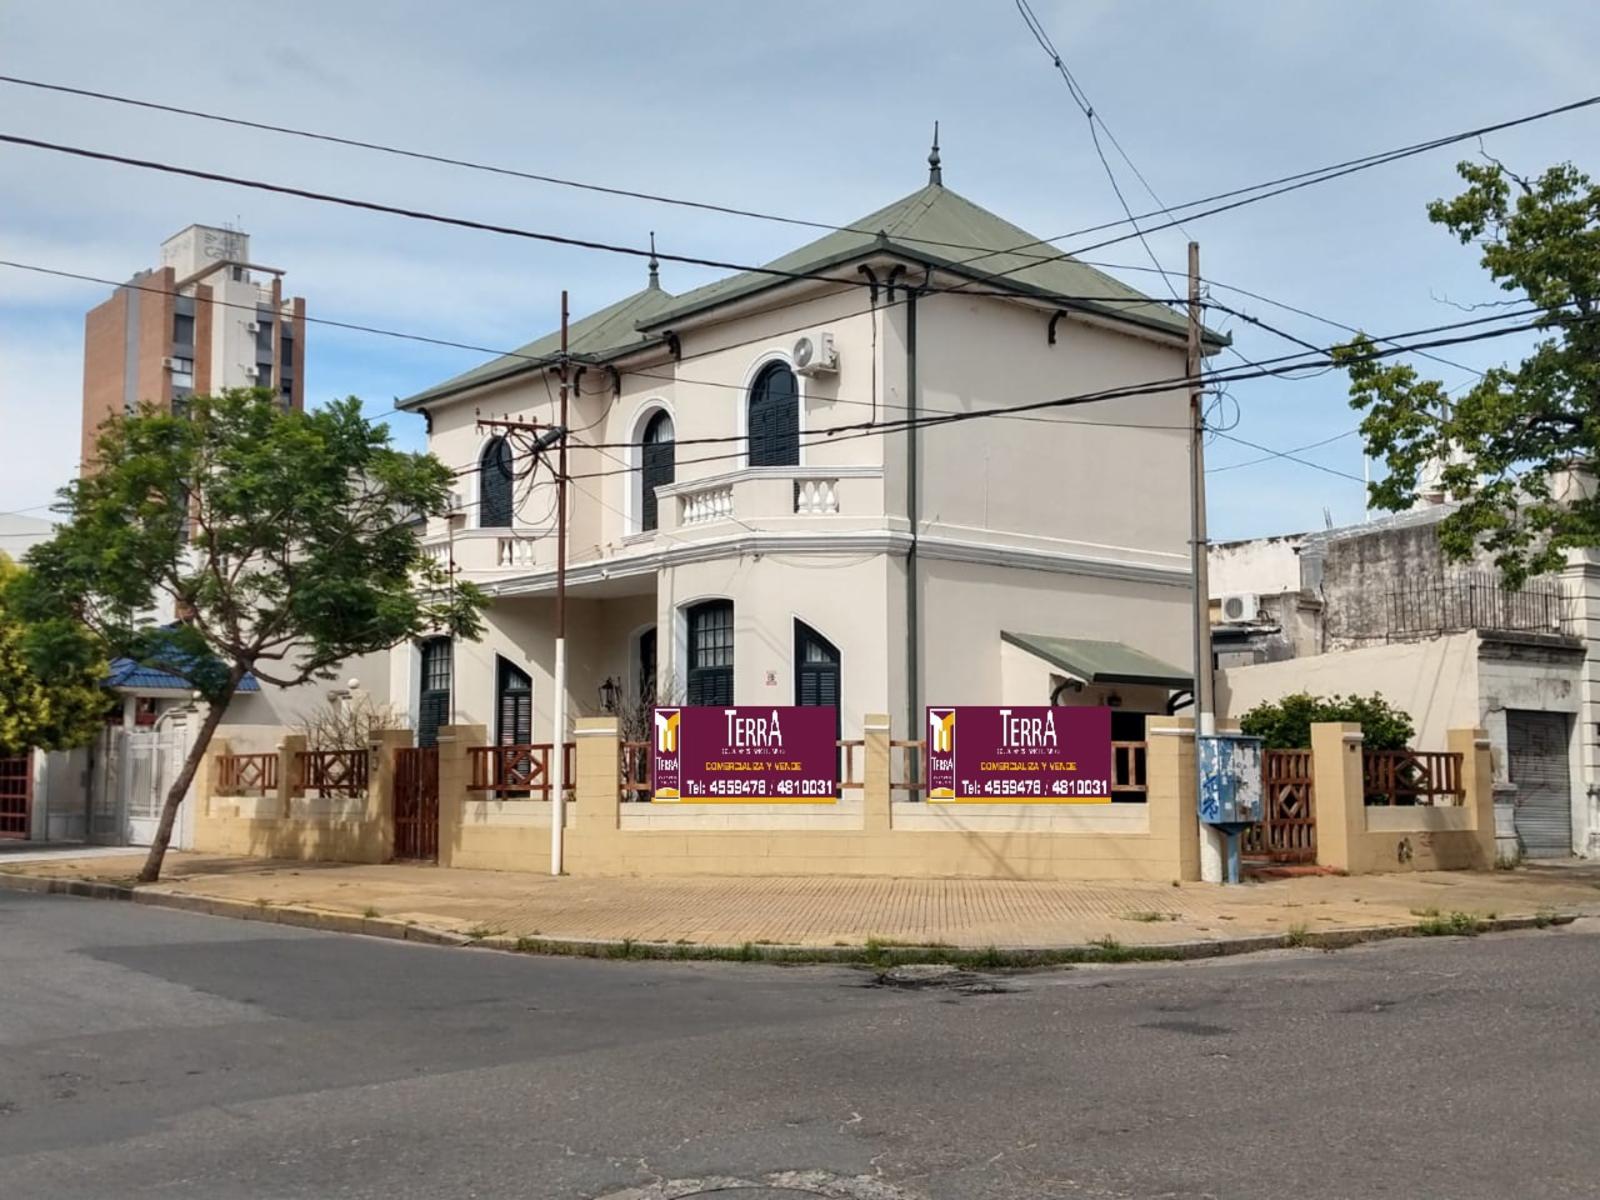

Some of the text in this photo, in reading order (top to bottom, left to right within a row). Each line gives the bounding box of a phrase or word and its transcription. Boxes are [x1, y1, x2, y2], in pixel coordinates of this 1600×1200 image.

[724, 709, 782, 747] TERRA
[999, 709, 1057, 747] TERRA
[766, 761, 773, 771] Y
[774, 761, 802, 771] VENDE
[1041, 761, 1048, 771] Y
[1049, 761, 1077, 771] VENDE
[776, 780, 832, 795] 4810031
[1051, 780, 1107, 795] 4810031
